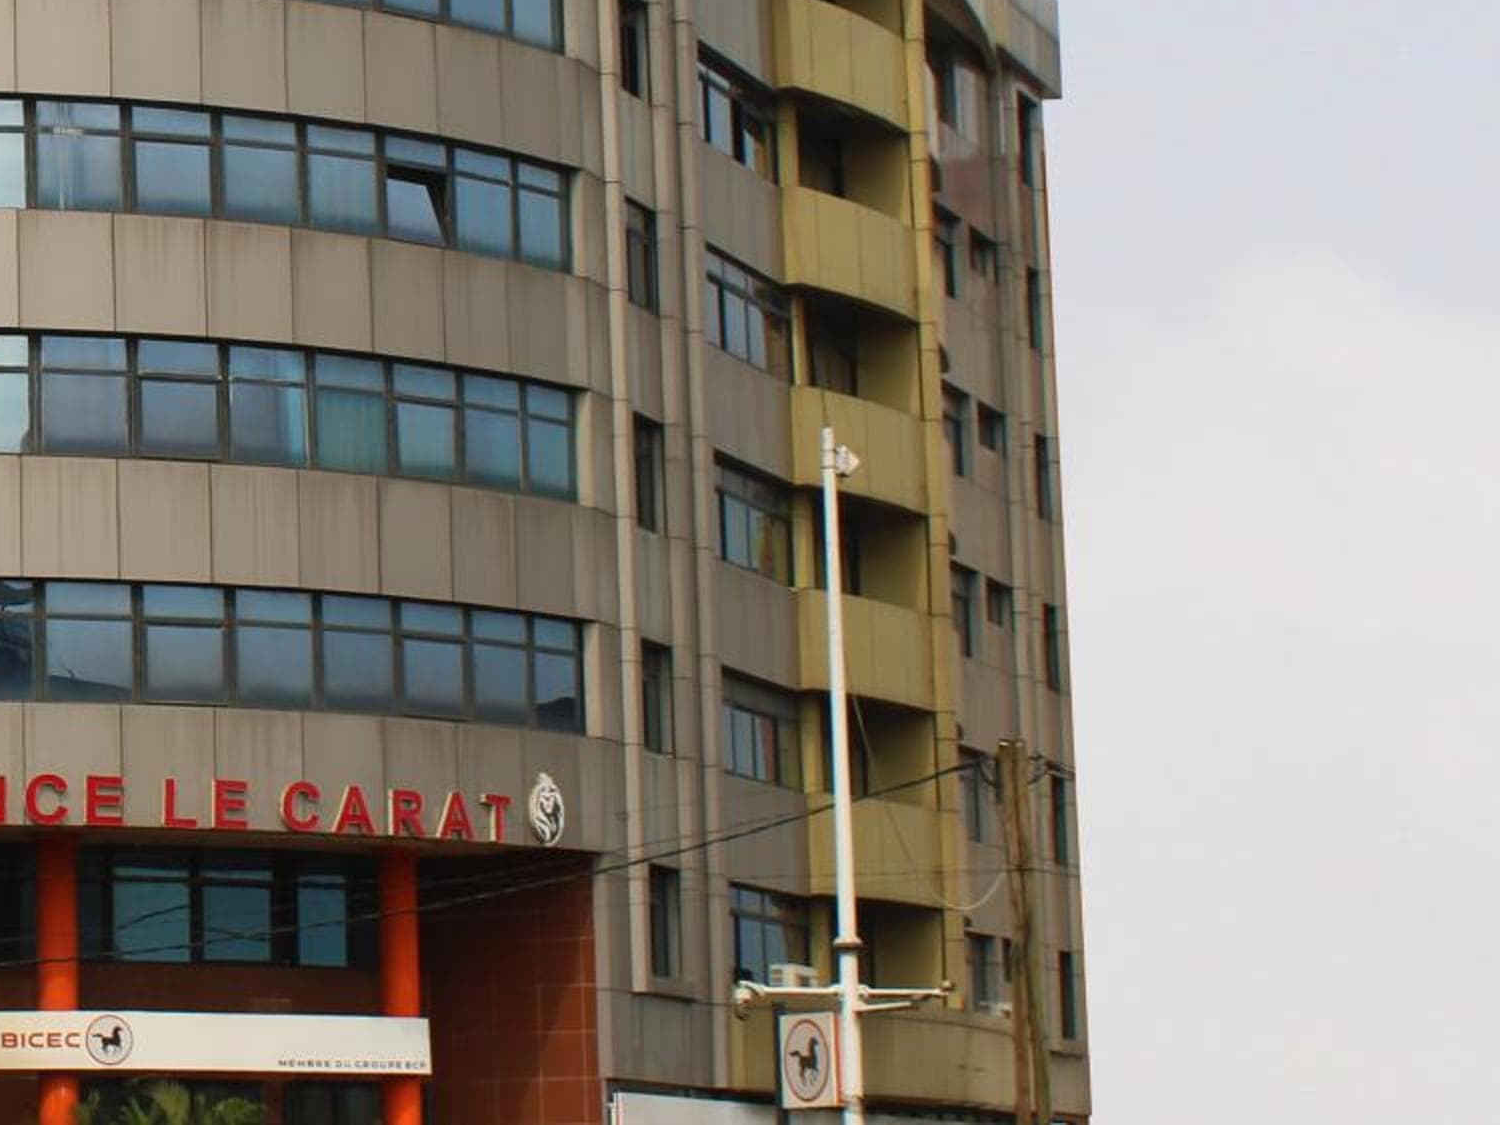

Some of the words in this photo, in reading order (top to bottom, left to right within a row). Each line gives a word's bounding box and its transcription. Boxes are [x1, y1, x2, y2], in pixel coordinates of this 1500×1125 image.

[162, 778, 247, 830] LE
[280, 779, 512, 843] CARAT
[1, 1032, 81, 1048] BICEC
[335, 1060, 351, 1069] DU
